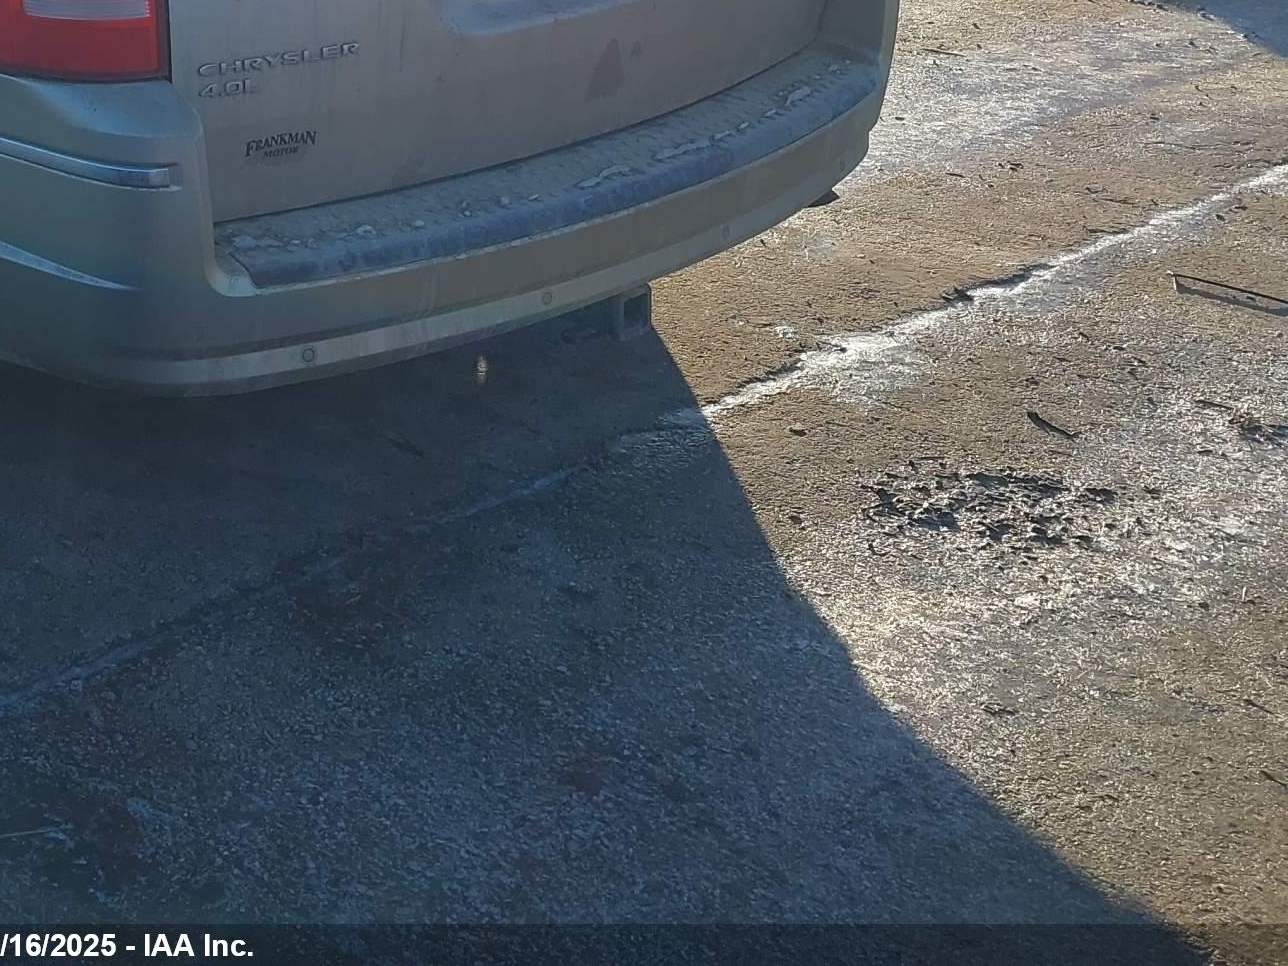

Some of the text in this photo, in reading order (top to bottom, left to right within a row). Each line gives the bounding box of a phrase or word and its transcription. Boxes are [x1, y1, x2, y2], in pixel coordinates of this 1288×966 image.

[197, 41, 361, 77] CHRYSLER
[198, 78, 260, 99] 4.0L
[244, 130, 318, 157] FRANKMAN
